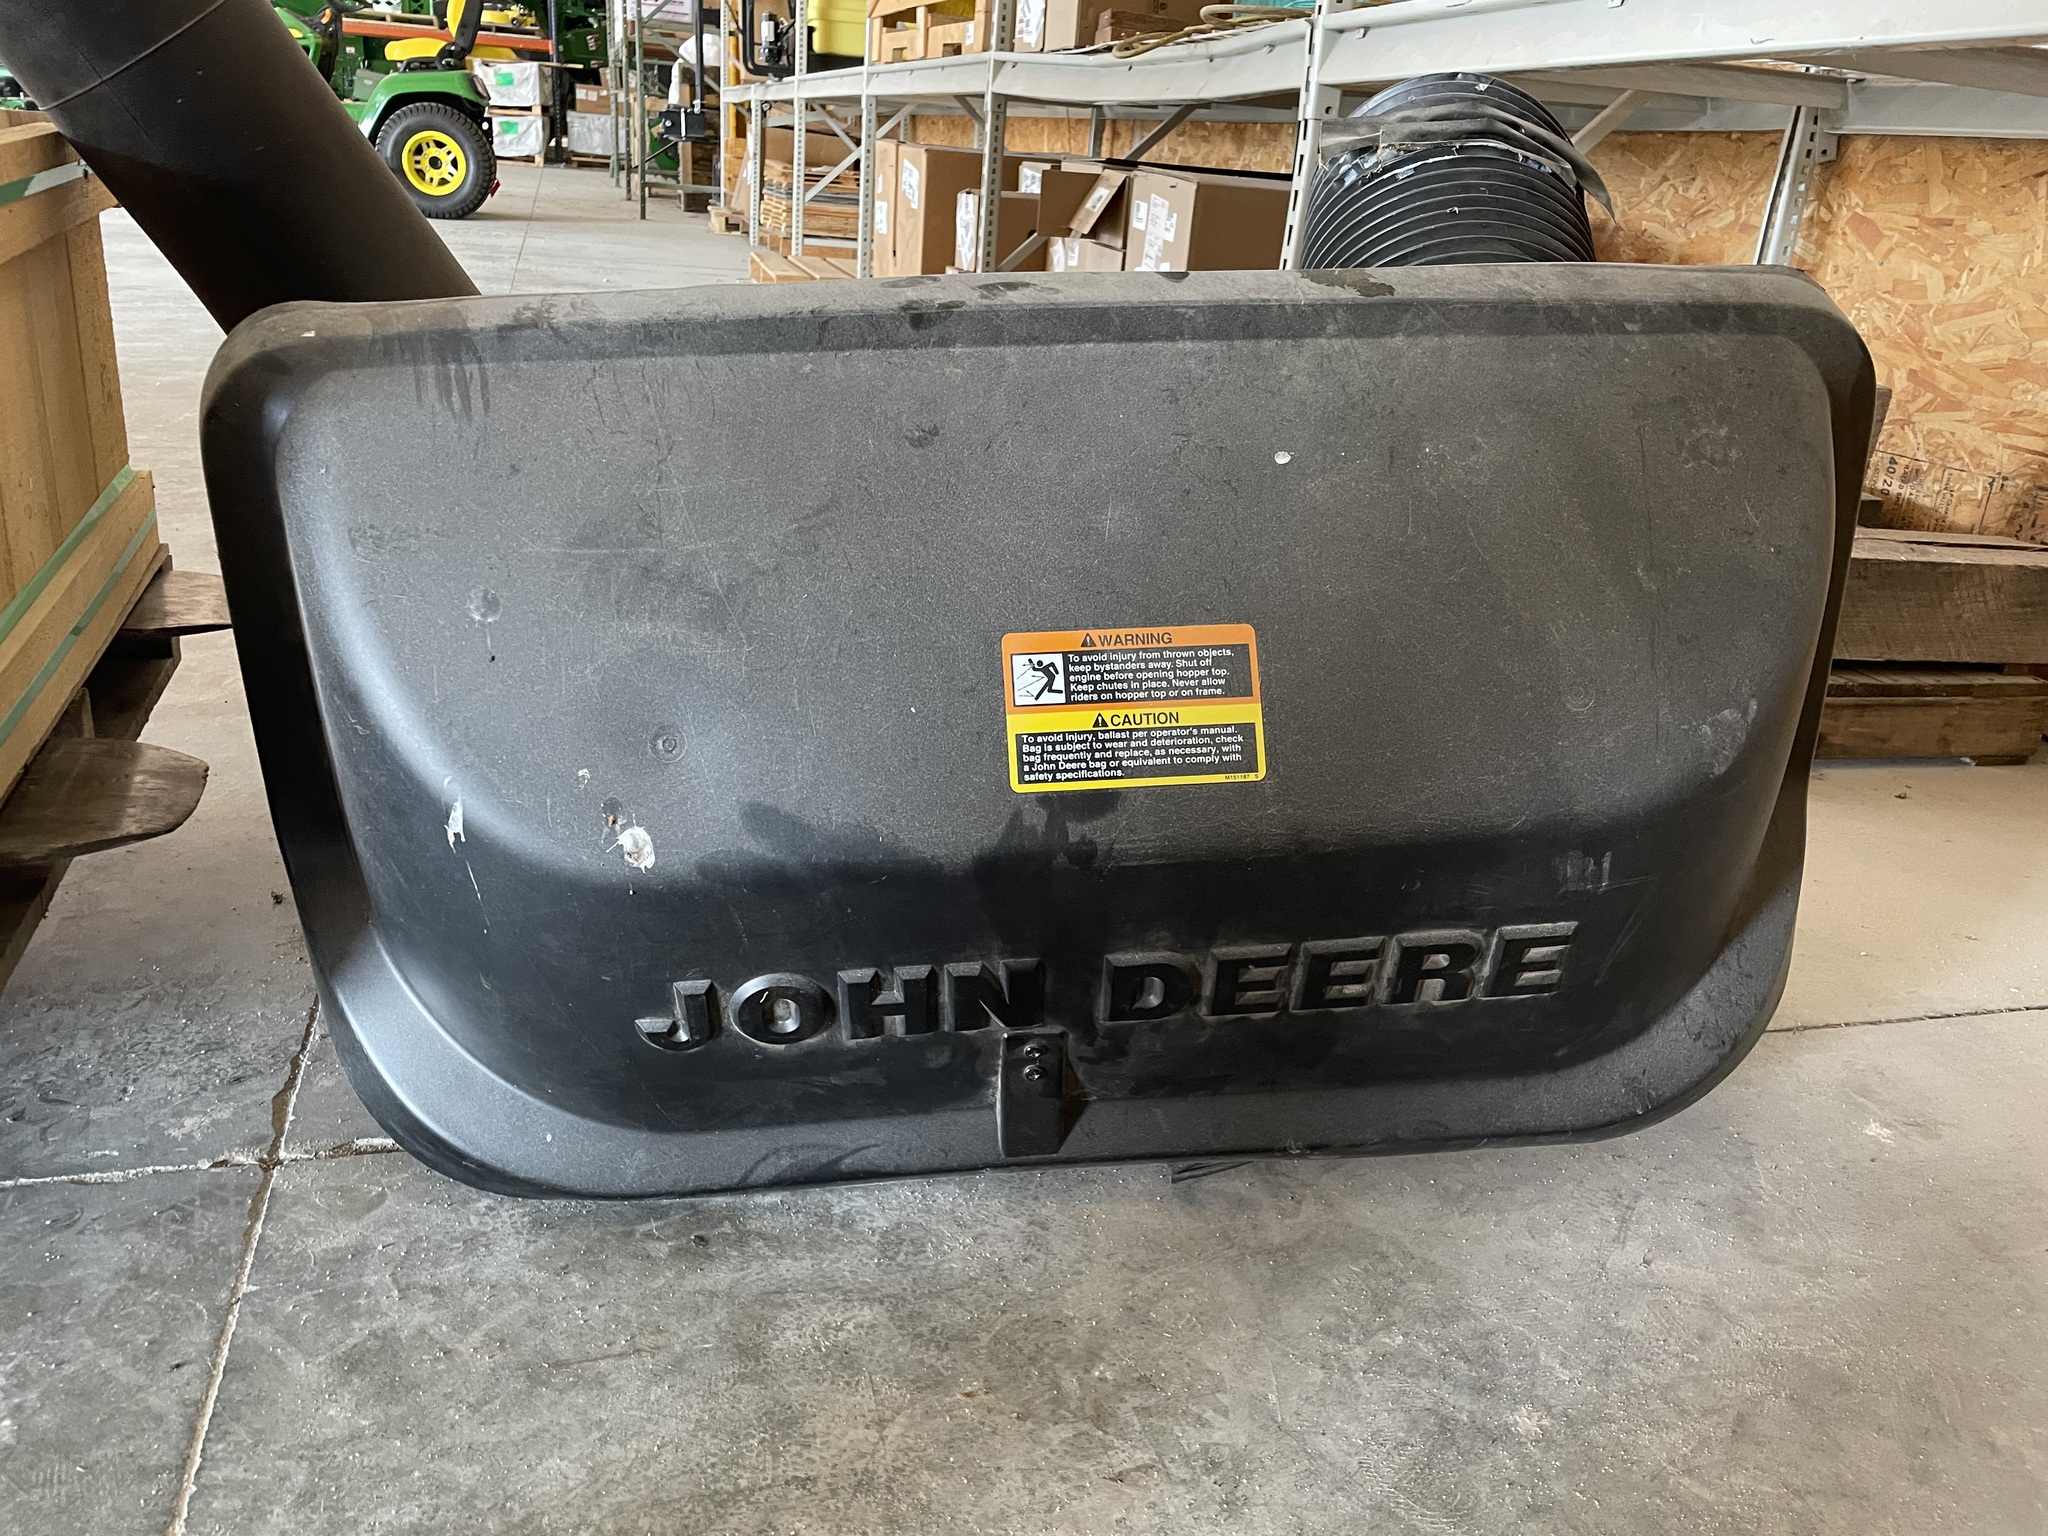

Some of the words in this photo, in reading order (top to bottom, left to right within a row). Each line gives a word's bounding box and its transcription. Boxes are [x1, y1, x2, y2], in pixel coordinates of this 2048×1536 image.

[1098, 632, 1172, 646] WARNING
[1068, 654, 1079, 662] To
[1082, 653, 1107, 662] avoid
[1110, 652, 1136, 662] injury
[1139, 651, 1160, 660] from
[1163, 650, 1195, 658] thrown
[1198, 649, 1234, 658] objects,
[1069, 664, 1091, 673] keep
[1094, 660, 1146, 672] bystanders
[1148, 662, 1173, 670] away.
[1176, 659, 1198, 668] Shut
[1201, 658, 1212, 666] off
[1069, 673, 1101, 683] engine
[1104, 671, 1133, 680] before
[1136, 670, 1174, 680] opening
[1176, 669, 1209, 678] hopper
[1212, 668, 1230, 677] top.
[1070, 683, 1094, 693] Keep
[1097, 682, 1128, 691] chutes
[1131, 680, 1139, 688] in
[1142, 679, 1170, 690] place.
[1172, 678, 1198, 687] Never
[1202, 677, 1225, 686] allow
[1071, 693, 1098, 701] riders
[1115, 691, 1148, 700] hopper
[1151, 690, 1166, 699] top
[1110, 712, 1179, 726] CAUTION
[1022, 735, 1034, 743] To
[1036, 733, 1063, 742] avoid
[1066, 732, 1096, 742] injury,
[1098, 731, 1130, 740] ballast
[1132, 730, 1147, 739] per
[1150, 727, 1198, 737] operator's
[1200, 726, 1238, 734] manual.
[1022, 745, 1042, 754] Bag
[1044, 744, 1052, 752] is
[1055, 742, 1090, 752] subject
[1130, 739, 1148, 747] and
[1150, 736, 1213, 746] deterioration,
[1216, 734, 1244, 743] check
[1023, 754, 1041, 763] bag
[1043, 751, 1092, 762] frequently
[1094, 750, 1112, 758] and
[1115, 749, 1152, 758] replace,
[1155, 748, 1166, 756] as
[1169, 746, 1219, 755] necessary,
[1222, 744, 1241, 752] with
[1032, 763, 1056, 771] John
[1059, 762, 1086, 770] Deere
[1089, 760, 1107, 770] bag
[1122, 757, 1171, 768] equivalent
[1173, 756, 1182, 764] to
[1185, 755, 1219, 764] comply
[1222, 754, 1242, 762] with
[1024, 772, 1053, 781] safety
[1056, 769, 1125, 781] specifications.
[634, 958, 1044, 1052] JOHN
[1102, 921, 1577, 1023] DEERE
